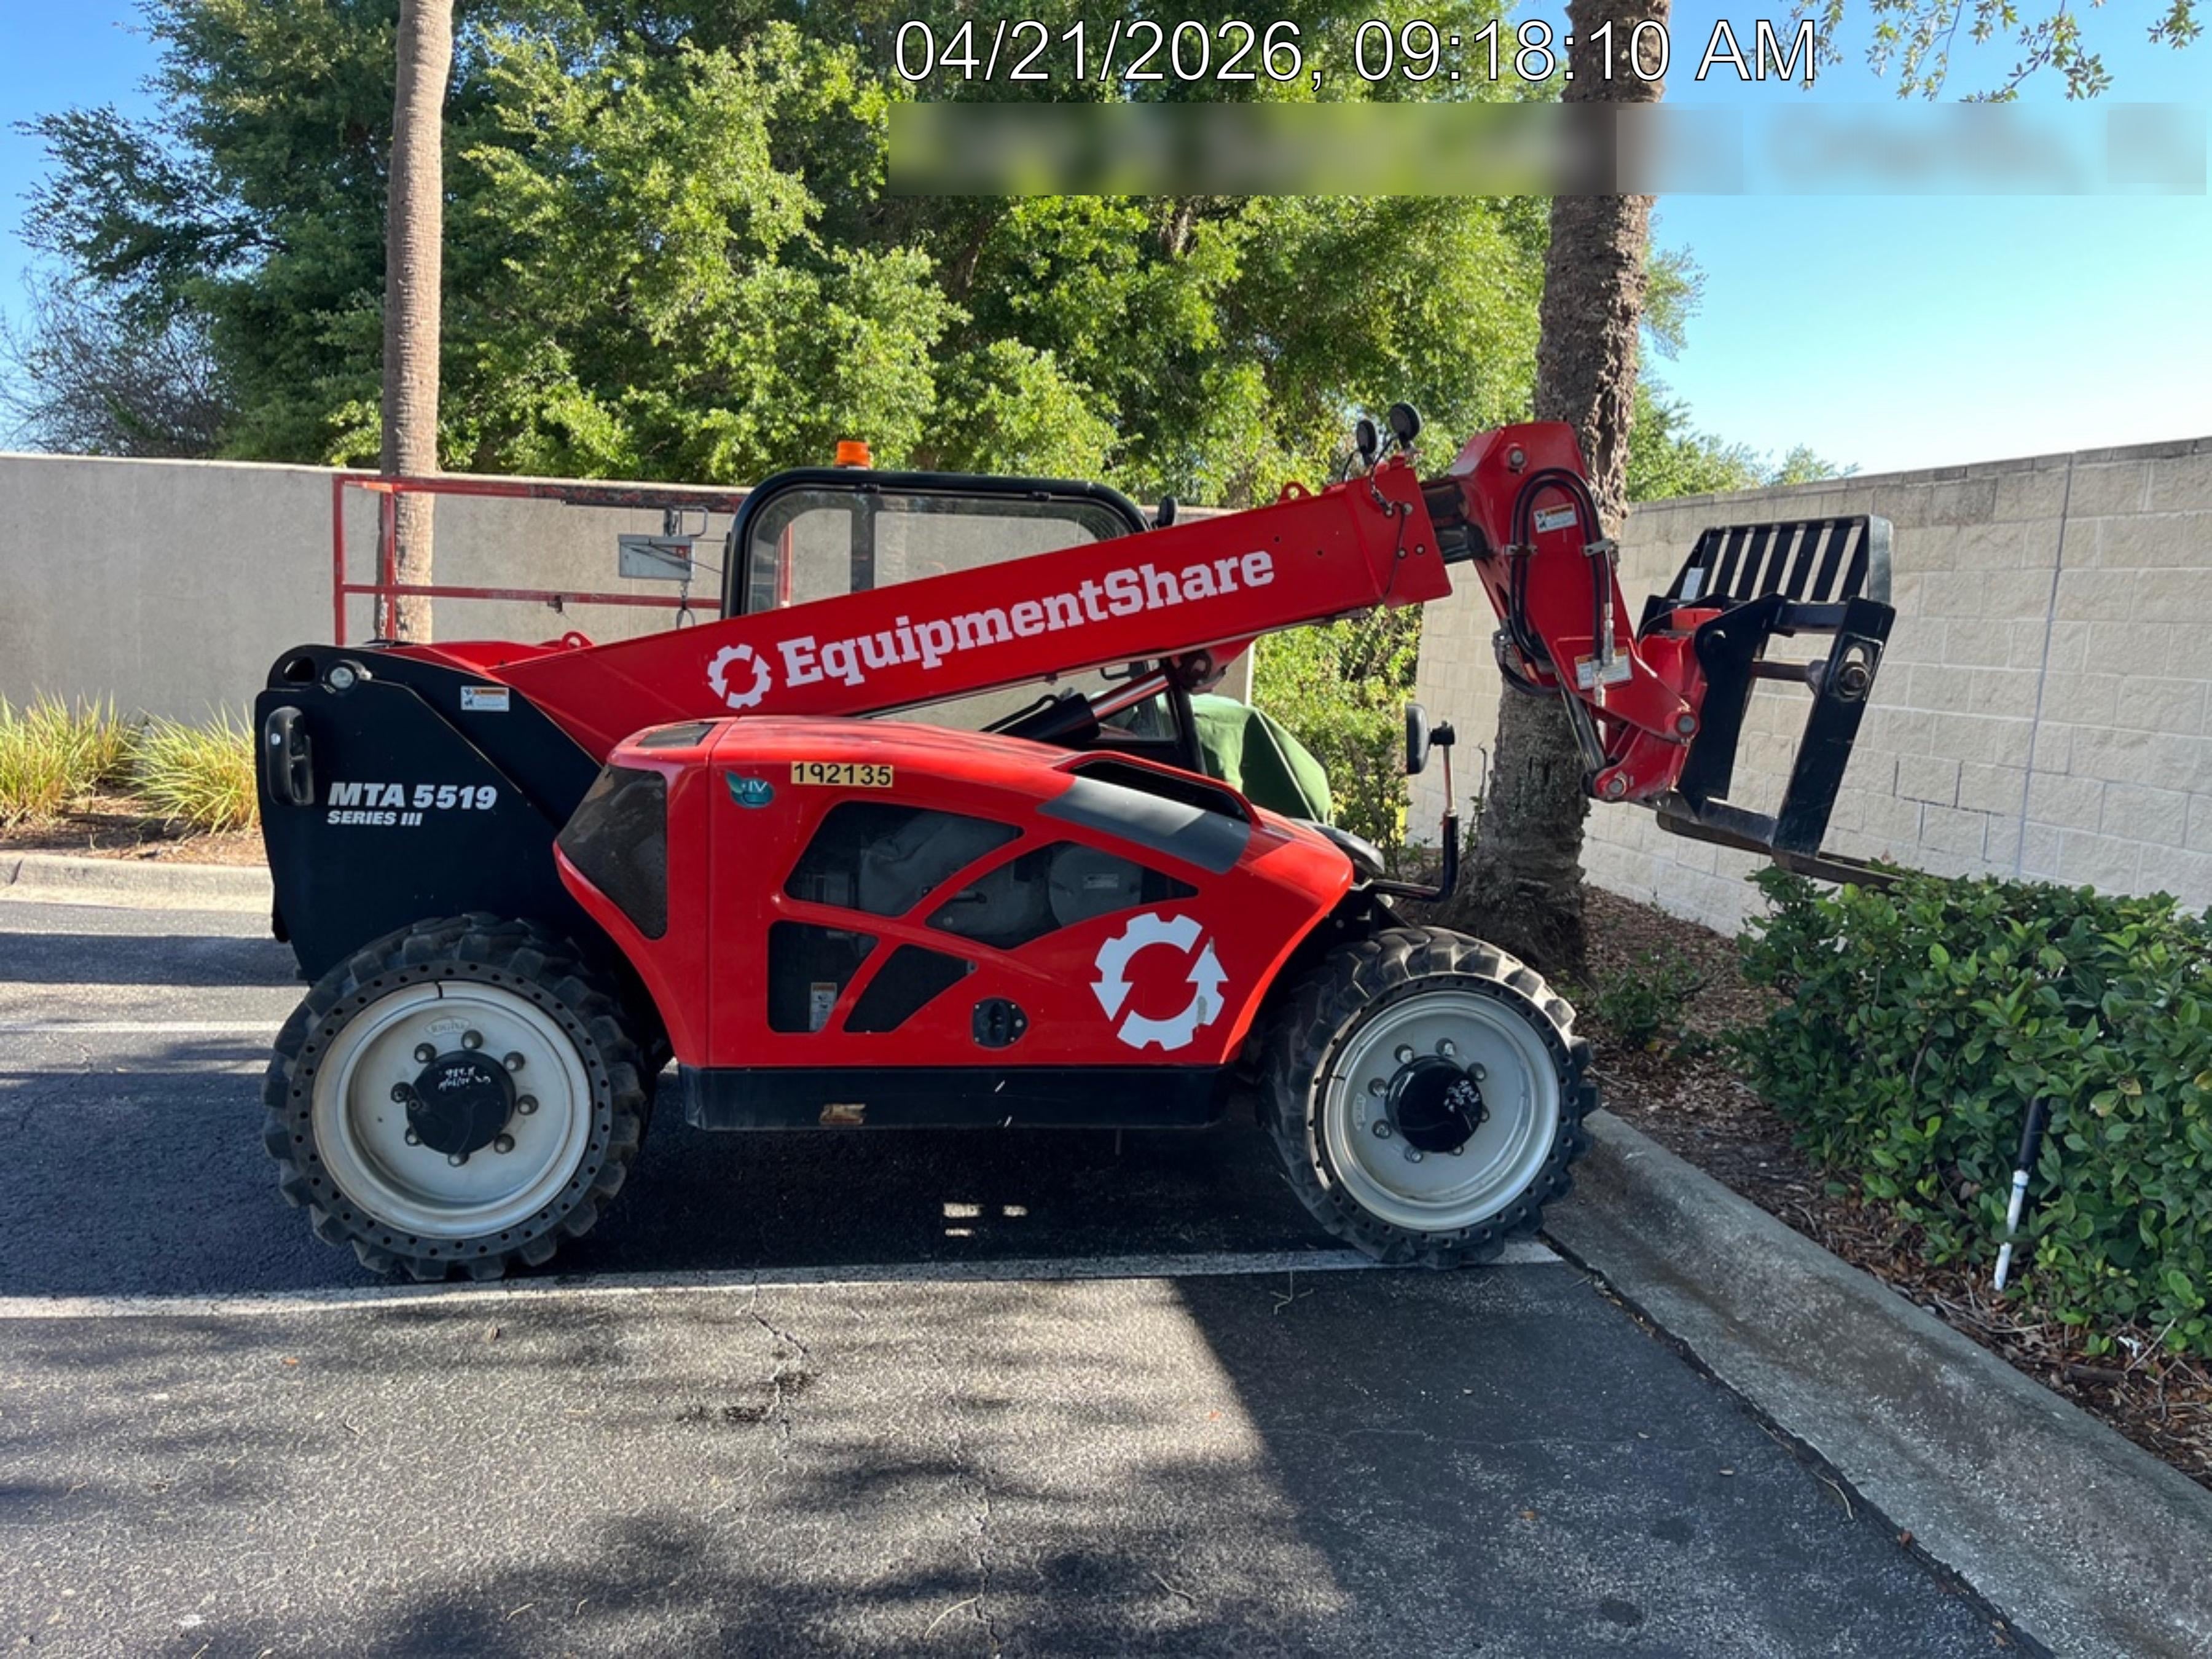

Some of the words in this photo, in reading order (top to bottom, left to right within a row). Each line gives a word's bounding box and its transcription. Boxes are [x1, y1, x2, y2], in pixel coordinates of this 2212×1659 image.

[778, 549, 1274, 687] EquipmentShare
[794, 763, 891, 786] 192135
[329, 782, 404, 807] MTA
[413, 785, 496, 809] 5519
[327, 811, 396, 825] SERIES
[400, 812, 423, 826] III
